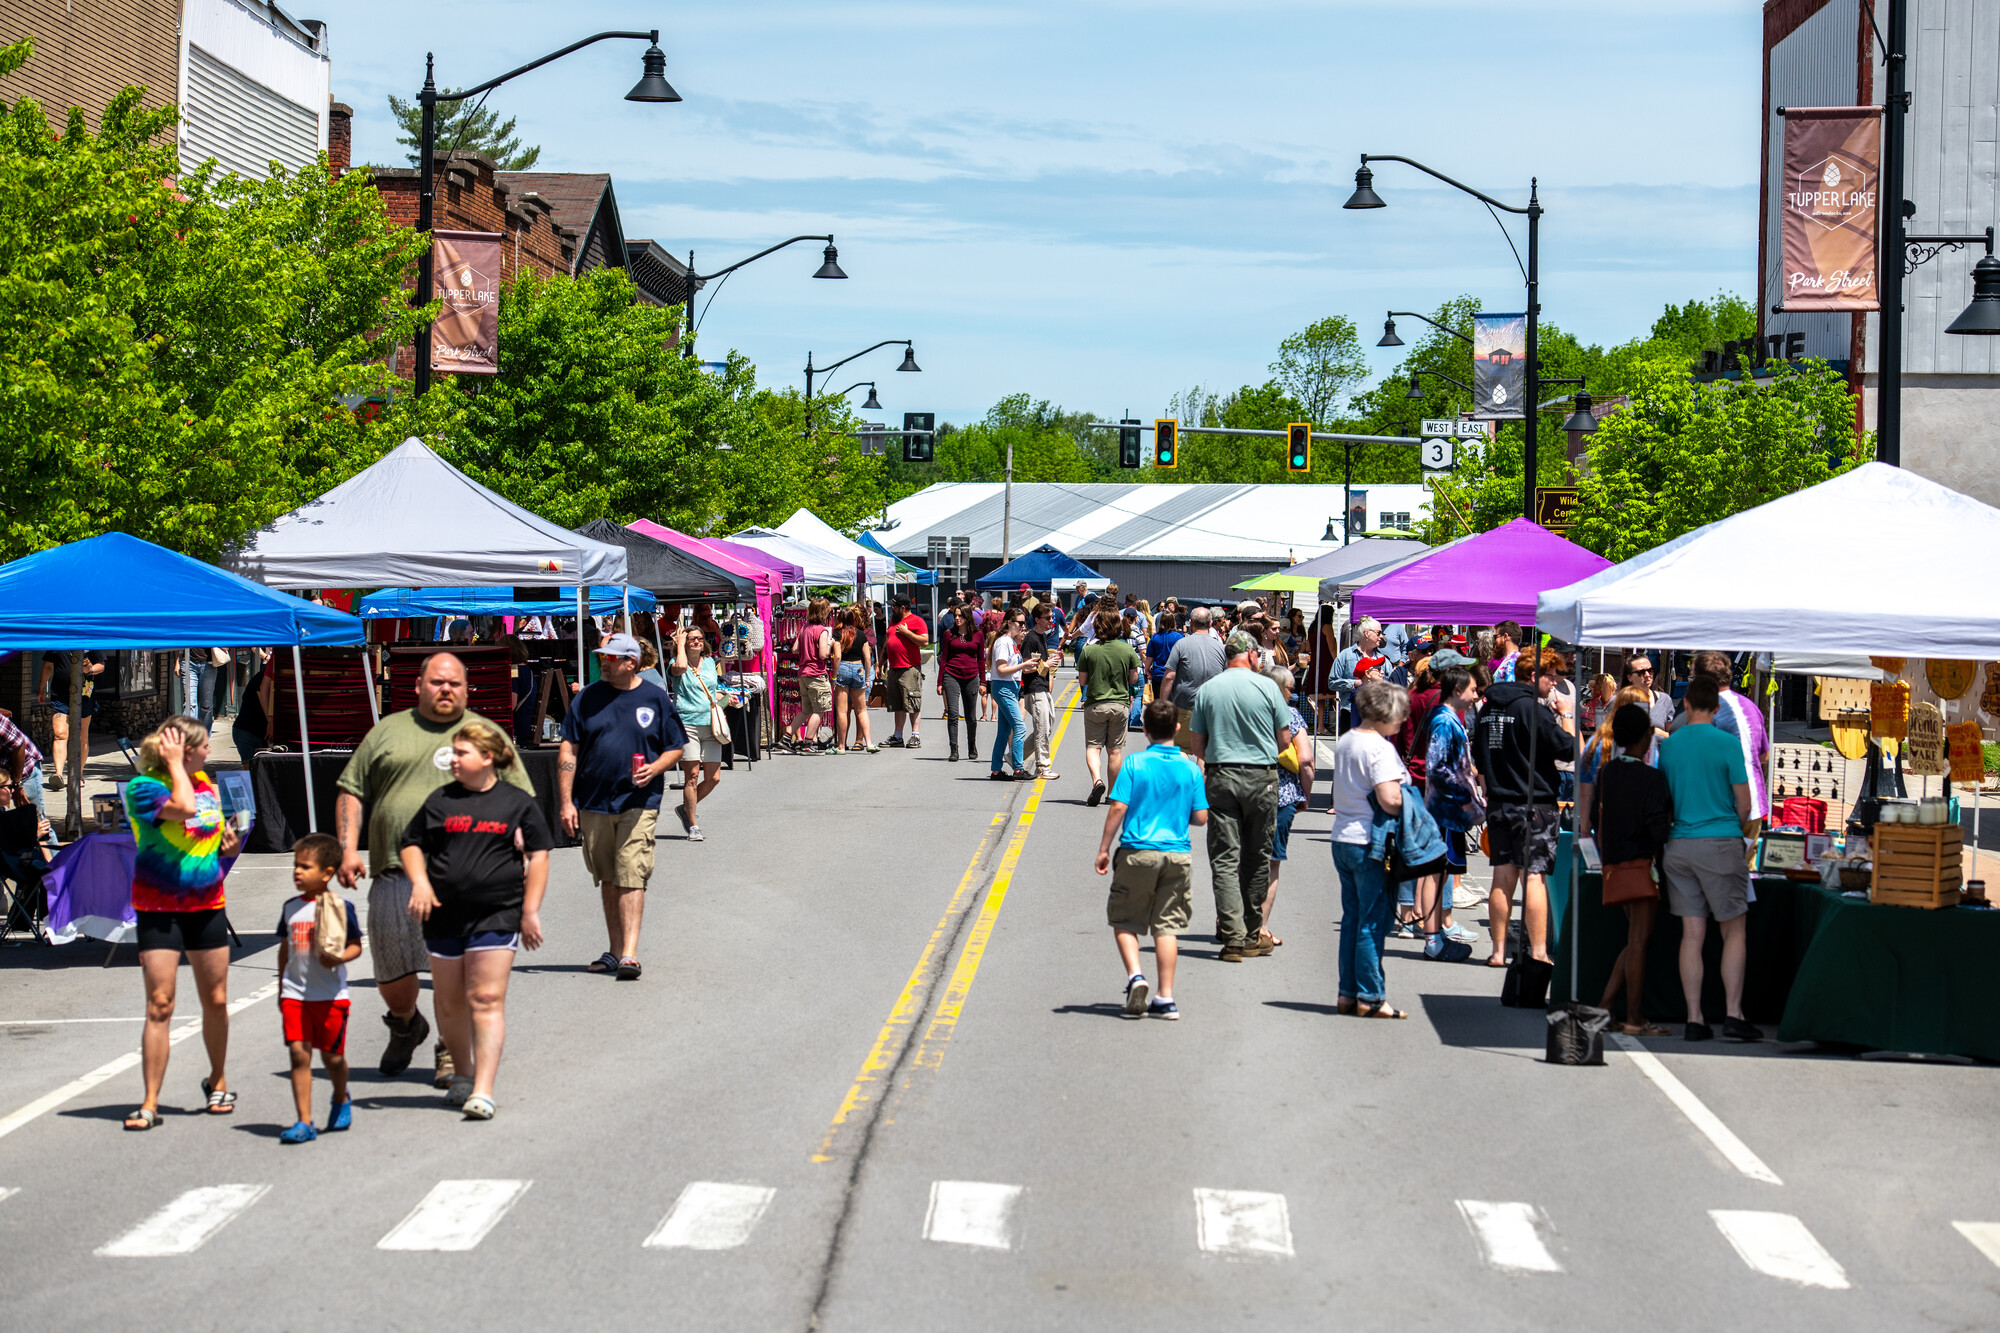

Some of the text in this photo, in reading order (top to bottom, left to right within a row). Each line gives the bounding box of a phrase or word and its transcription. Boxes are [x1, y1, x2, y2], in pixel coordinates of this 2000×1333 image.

[1788, 191, 1876, 209] TUPPER LAKE
[1787, 269, 1875, 293] Park Street
[437, 288, 496, 303] TUPPER LAKE
[434, 344, 494, 360] Park Street
[1426, 423, 1450, 433] WEST
[1461, 423, 1484, 434] EAST
[1431, 444, 1444, 462] 3
[1559, 496, 1578, 505] Wild
[1553, 508, 1573, 518] Cen
[1918, 749, 1938, 761] ARE
[472, 820, 508, 834] JACKS
